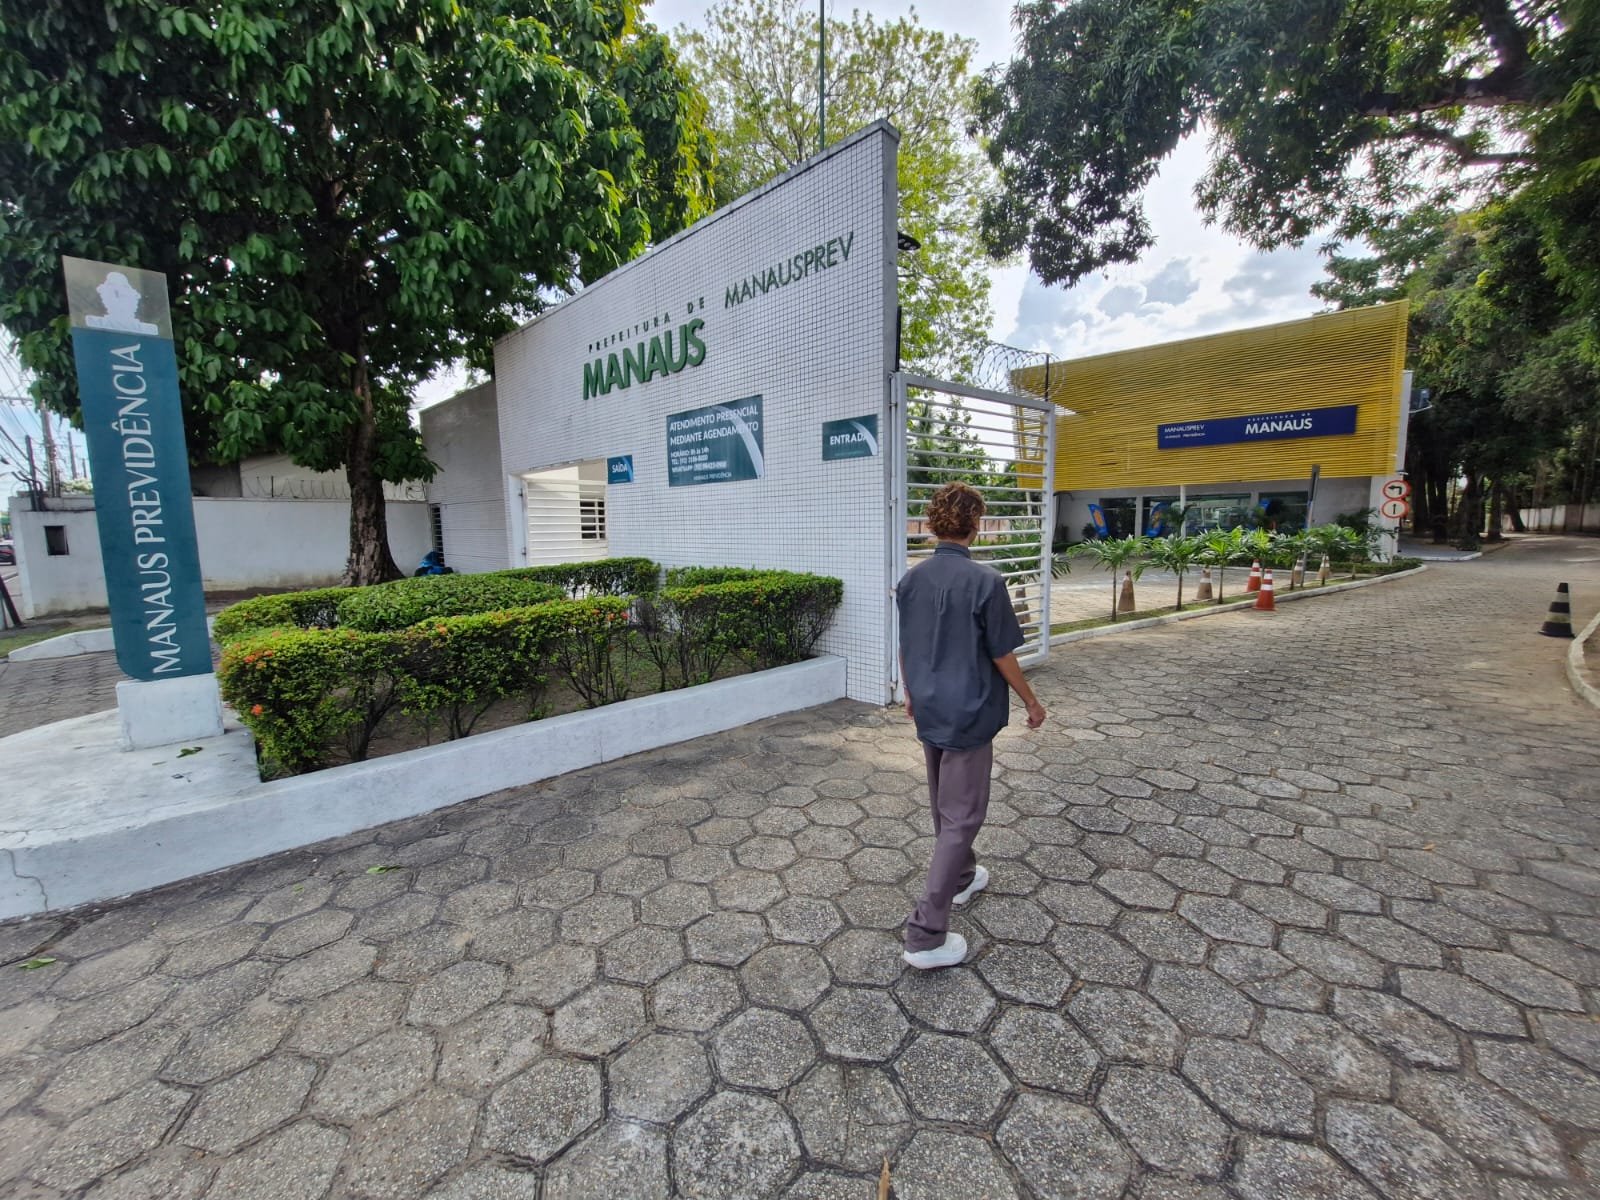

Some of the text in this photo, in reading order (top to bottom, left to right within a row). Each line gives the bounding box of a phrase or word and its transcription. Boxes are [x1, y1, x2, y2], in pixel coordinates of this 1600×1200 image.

[724, 231, 854, 309] MANAUSPREV
[588, 297, 705, 353] PREFEITURA DE
[582, 317, 707, 401] MANAUS
[669, 404, 758, 432] ATENDIMENTO PRESENCIAL
[670, 421, 759, 446] MEDIANTE AGENDAMTO
[1245, 417, 1313, 435] MANAUS
[611, 461, 628, 473] SAÍDA
[110, 343, 182, 674] MANAUS PREVIDÊNCIA
